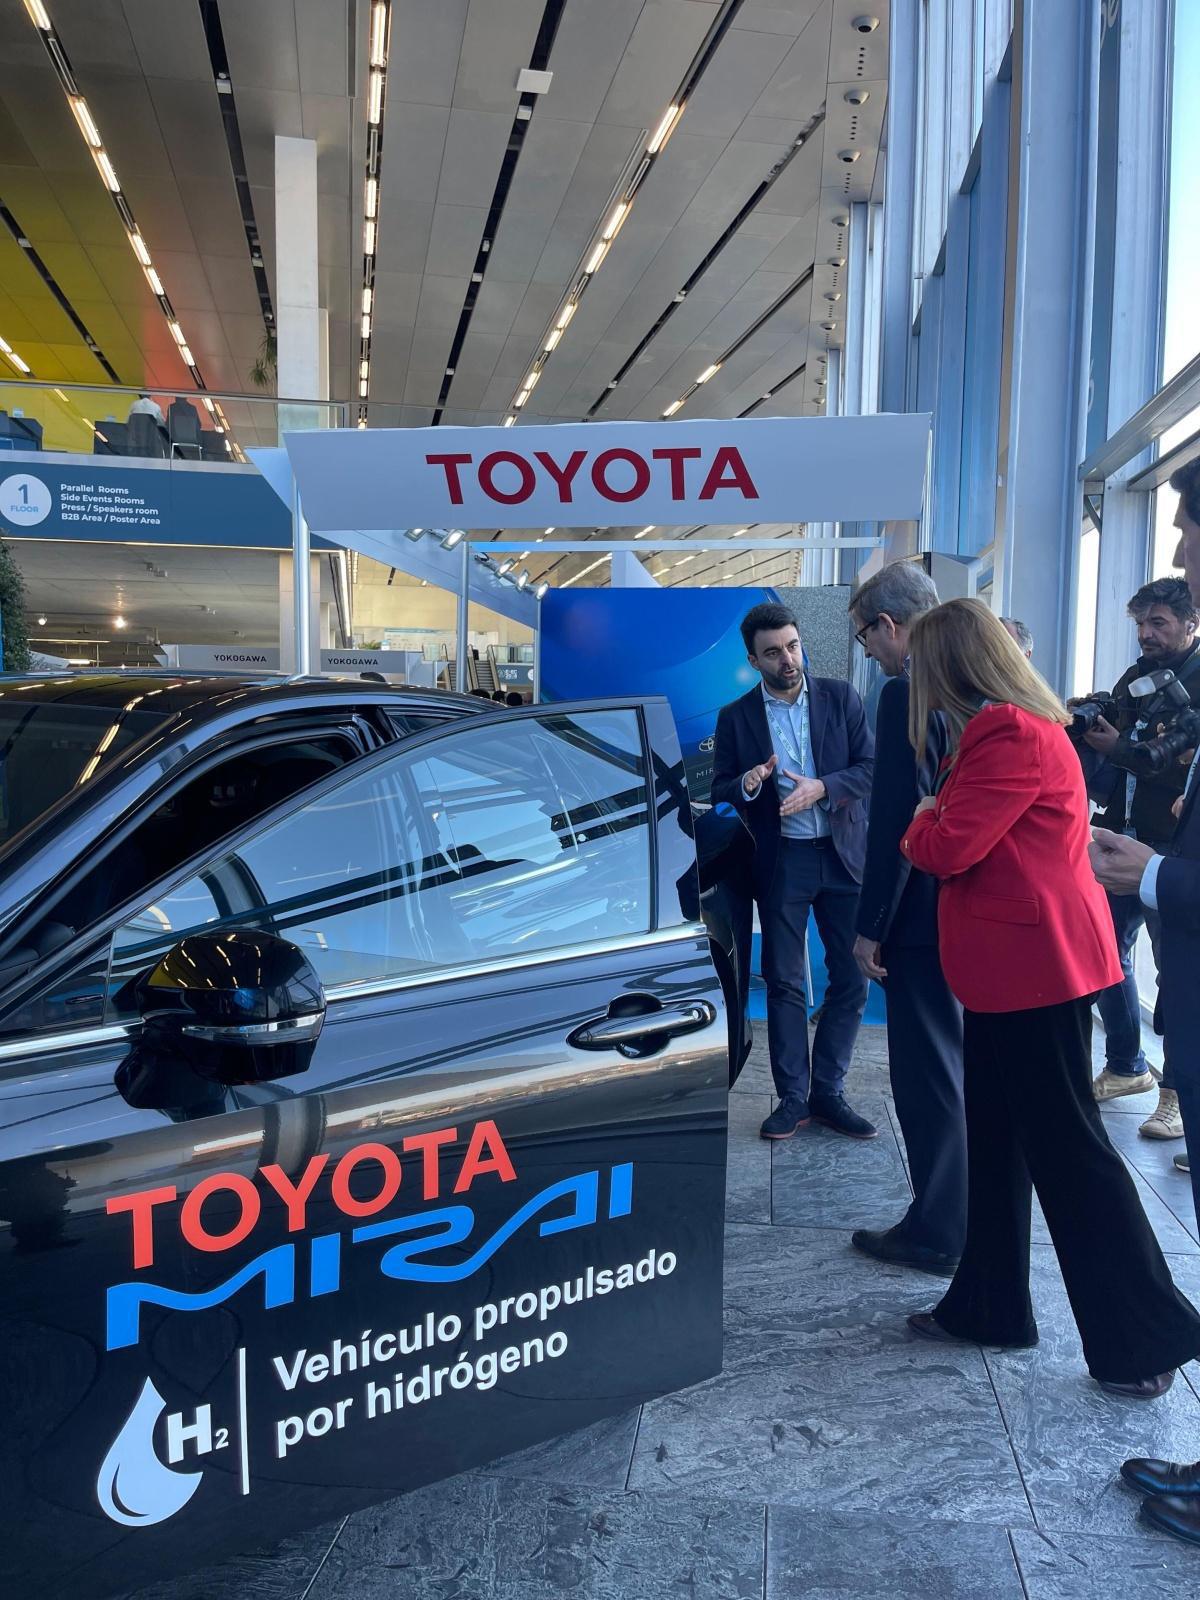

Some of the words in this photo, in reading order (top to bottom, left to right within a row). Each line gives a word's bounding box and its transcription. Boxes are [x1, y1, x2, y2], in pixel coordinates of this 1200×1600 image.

[425, 446, 760, 505] TOYOTA
[18, 483, 29, 504] 1
[60, 483, 94, 493] Parallel
[98, 486, 129, 495] Rooms
[60, 493, 80, 502] Side
[83, 494, 112, 503] Events
[114, 496, 145, 505] Rooms
[10, 505, 39, 513] FLOOR
[61, 503, 86, 512] Press
[87, 504, 91, 513] /
[93, 505, 134, 515] Speakers
[135, 507, 159, 515] room
[61, 513, 80, 521] B2B
[82, 514, 102, 522] Area
[104, 514, 109, 523] /
[110, 515, 138, 524] Poster
[140, 517, 161, 525] Area
[214, 654, 267, 663] YOKOGAWA
[328, 657, 379, 666] YOKOGAWA
[106, 1120, 517, 1269] TOYOTA
[106, 1162, 634, 1351] MIRAI
[273, 1311, 462, 1391] Vehículo
[475, 1249, 677, 1342] propulsado
[277, 1398, 354, 1459] por
[367, 1331, 568, 1419] hidrógeno
